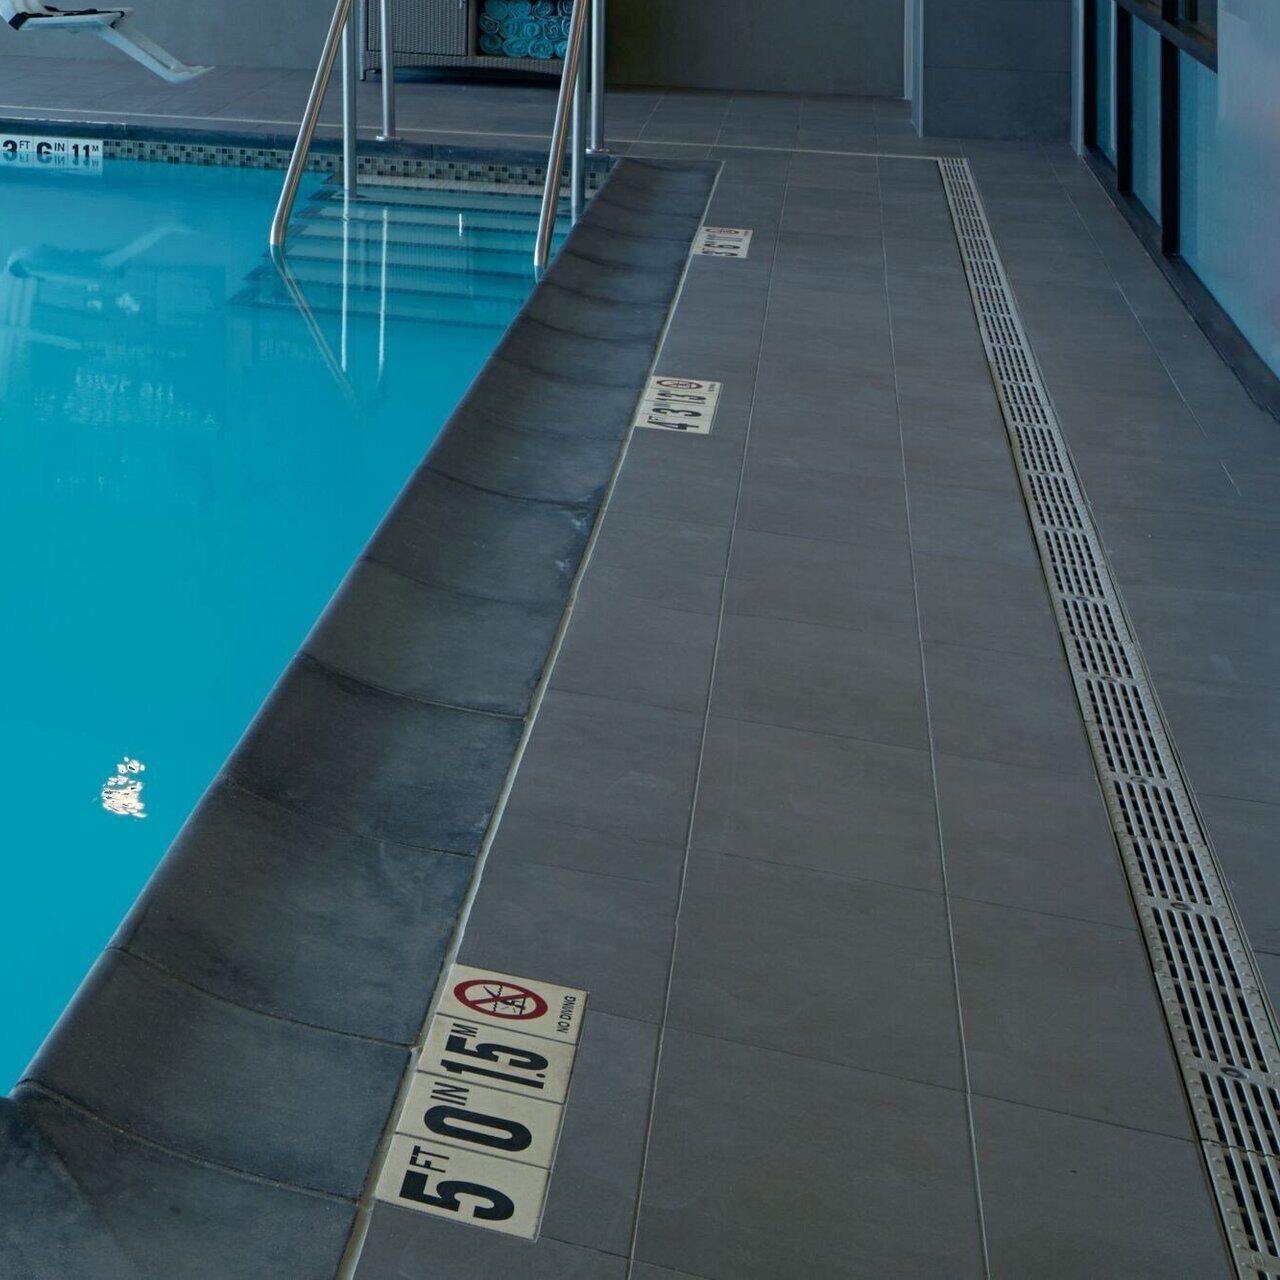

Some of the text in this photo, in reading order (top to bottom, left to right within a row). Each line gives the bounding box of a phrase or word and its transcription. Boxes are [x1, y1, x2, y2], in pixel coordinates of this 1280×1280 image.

[19, 140, 31, 150] FT
[54, 142, 65, 152] IN
[652, 407, 702, 417] 3
[647, 420, 699, 430] 4
[556, 995, 577, 1034] NO DIVING
[399, 1023, 549, 1220] 5 FT 0 IN 1.5 M
